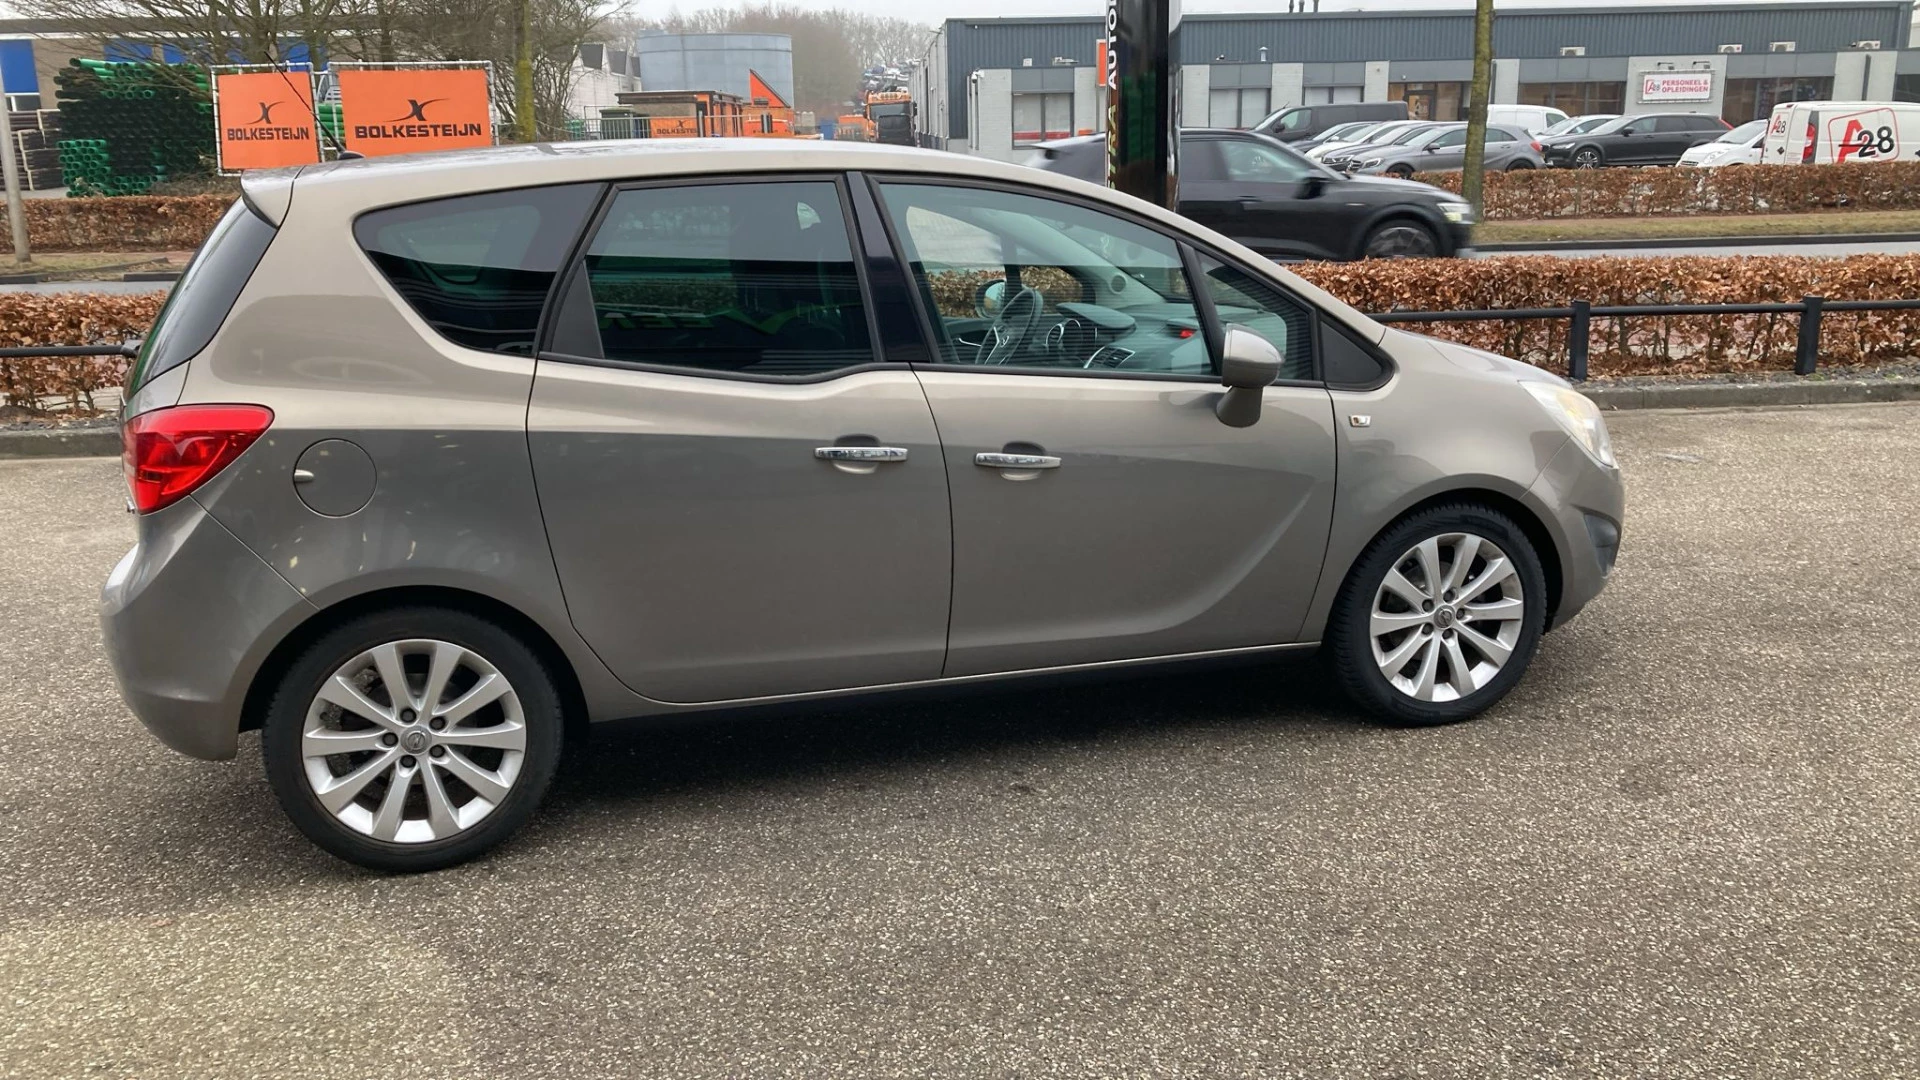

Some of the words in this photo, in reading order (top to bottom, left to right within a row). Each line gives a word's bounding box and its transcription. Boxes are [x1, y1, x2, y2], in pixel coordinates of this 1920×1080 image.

[354, 123, 482, 139] BOLKESTEIJN
[1770, 113, 1787, 134] A28
[227, 127, 310, 141] BOLKESTEIJN
[1837, 119, 1895, 164] A28
